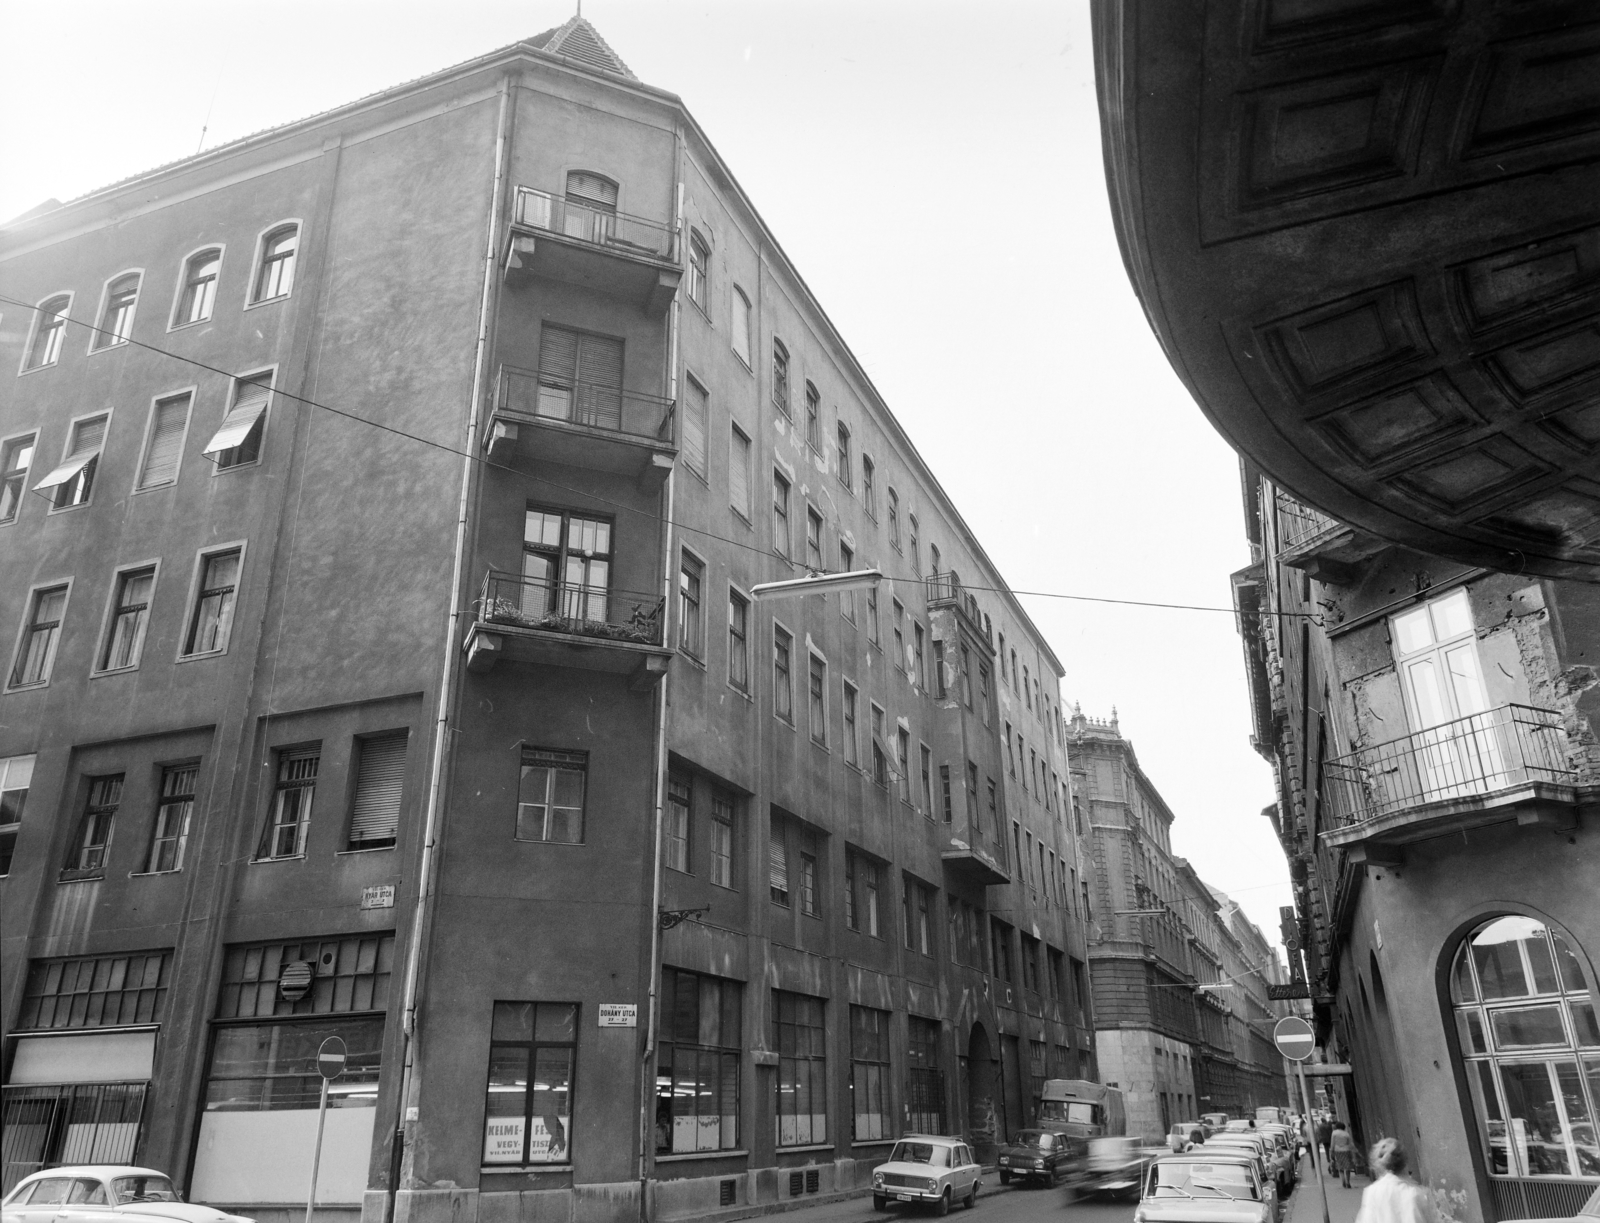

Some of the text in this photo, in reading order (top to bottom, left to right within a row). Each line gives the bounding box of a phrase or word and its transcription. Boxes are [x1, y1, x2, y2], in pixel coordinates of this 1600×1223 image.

[600, 1009, 621, 1017] DOHÁNY
[488, 1125, 523, 1136] KELME-
[497, 1140, 521, 1148] VEGY-
